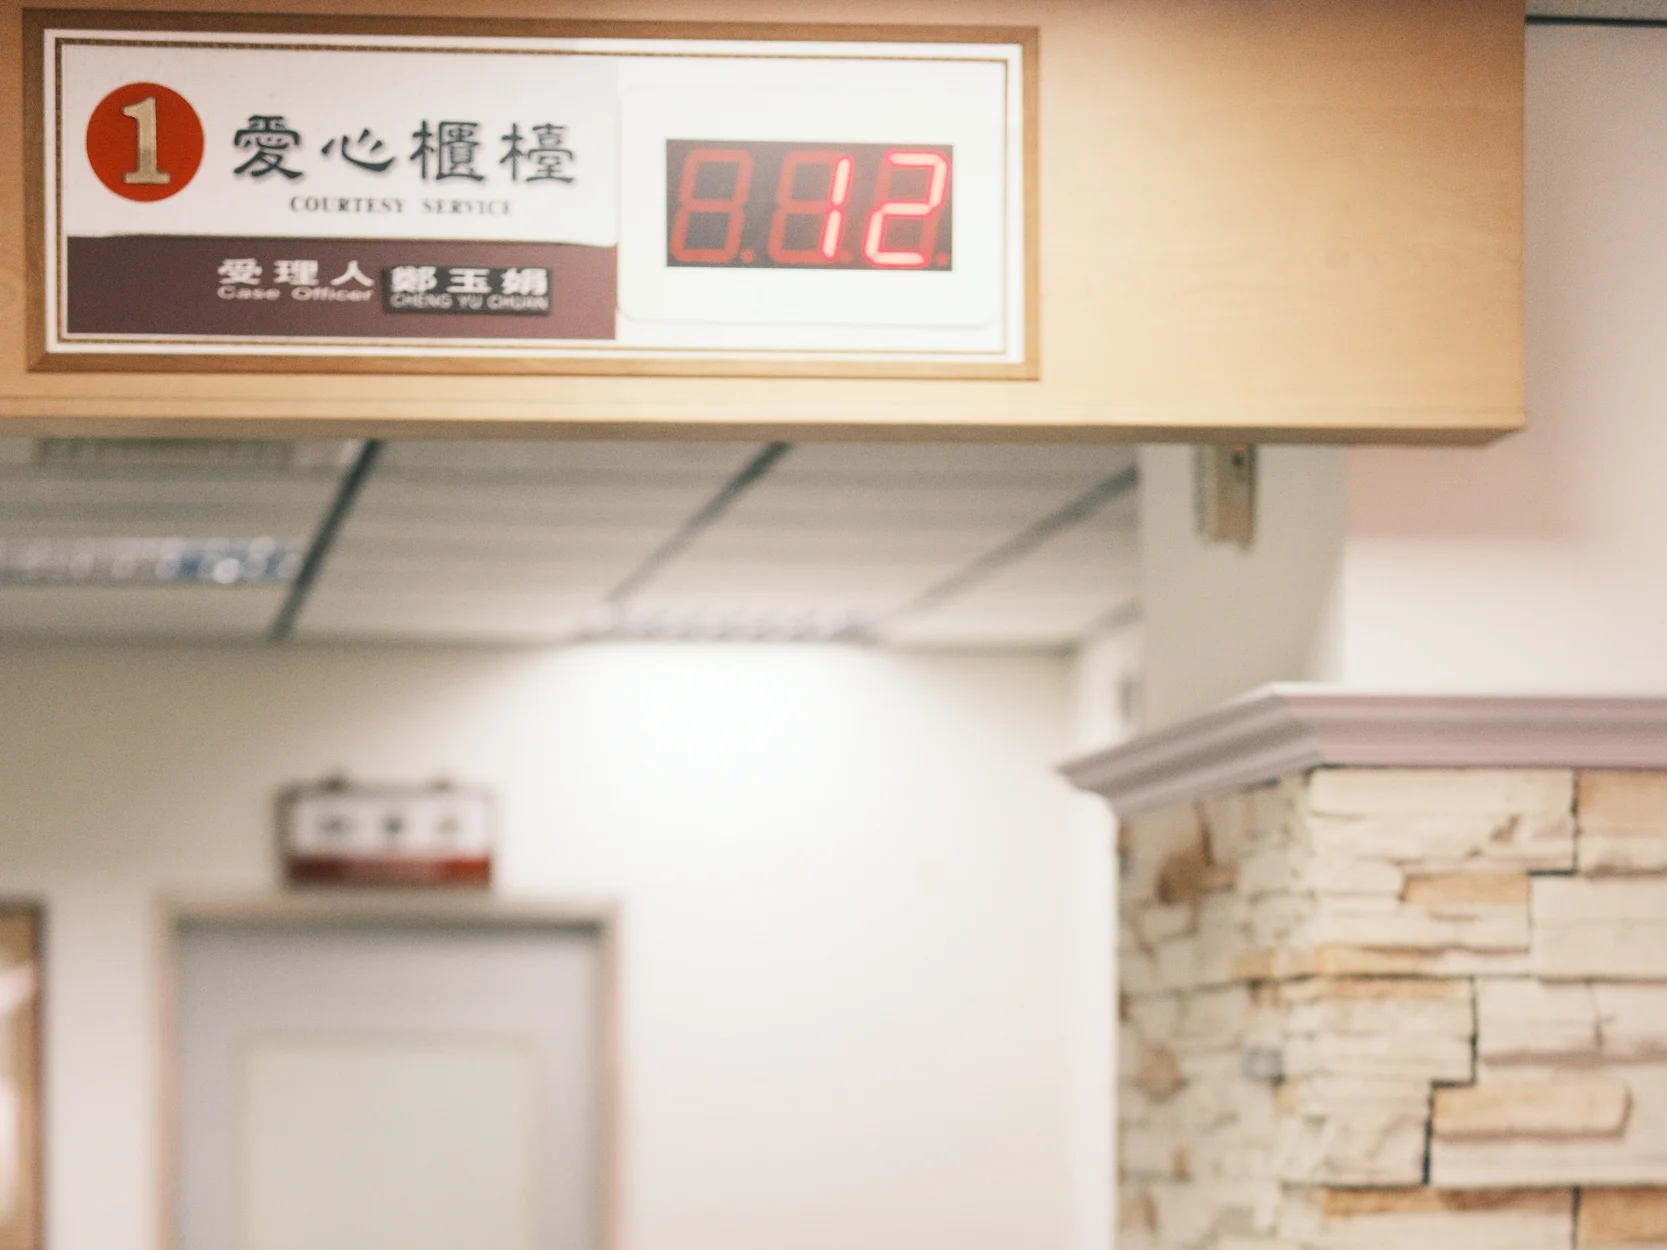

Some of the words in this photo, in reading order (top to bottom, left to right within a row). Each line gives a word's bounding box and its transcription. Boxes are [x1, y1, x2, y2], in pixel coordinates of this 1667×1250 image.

[121, 97, 172, 185] 1
[232, 114, 577, 186] 愛心櫃檯
[289, 195, 404, 214] COURTESY
[421, 198, 513, 216] SERVICE
[820, 150, 950, 268] 12
[217, 258, 375, 287] 受理人
[391, 265, 549, 296] 鄭玉娟
[217, 285, 281, 301] Case
[291, 286, 374, 302] Officer
[390, 293, 453, 309] CHENG
[456, 294, 484, 310] YU
